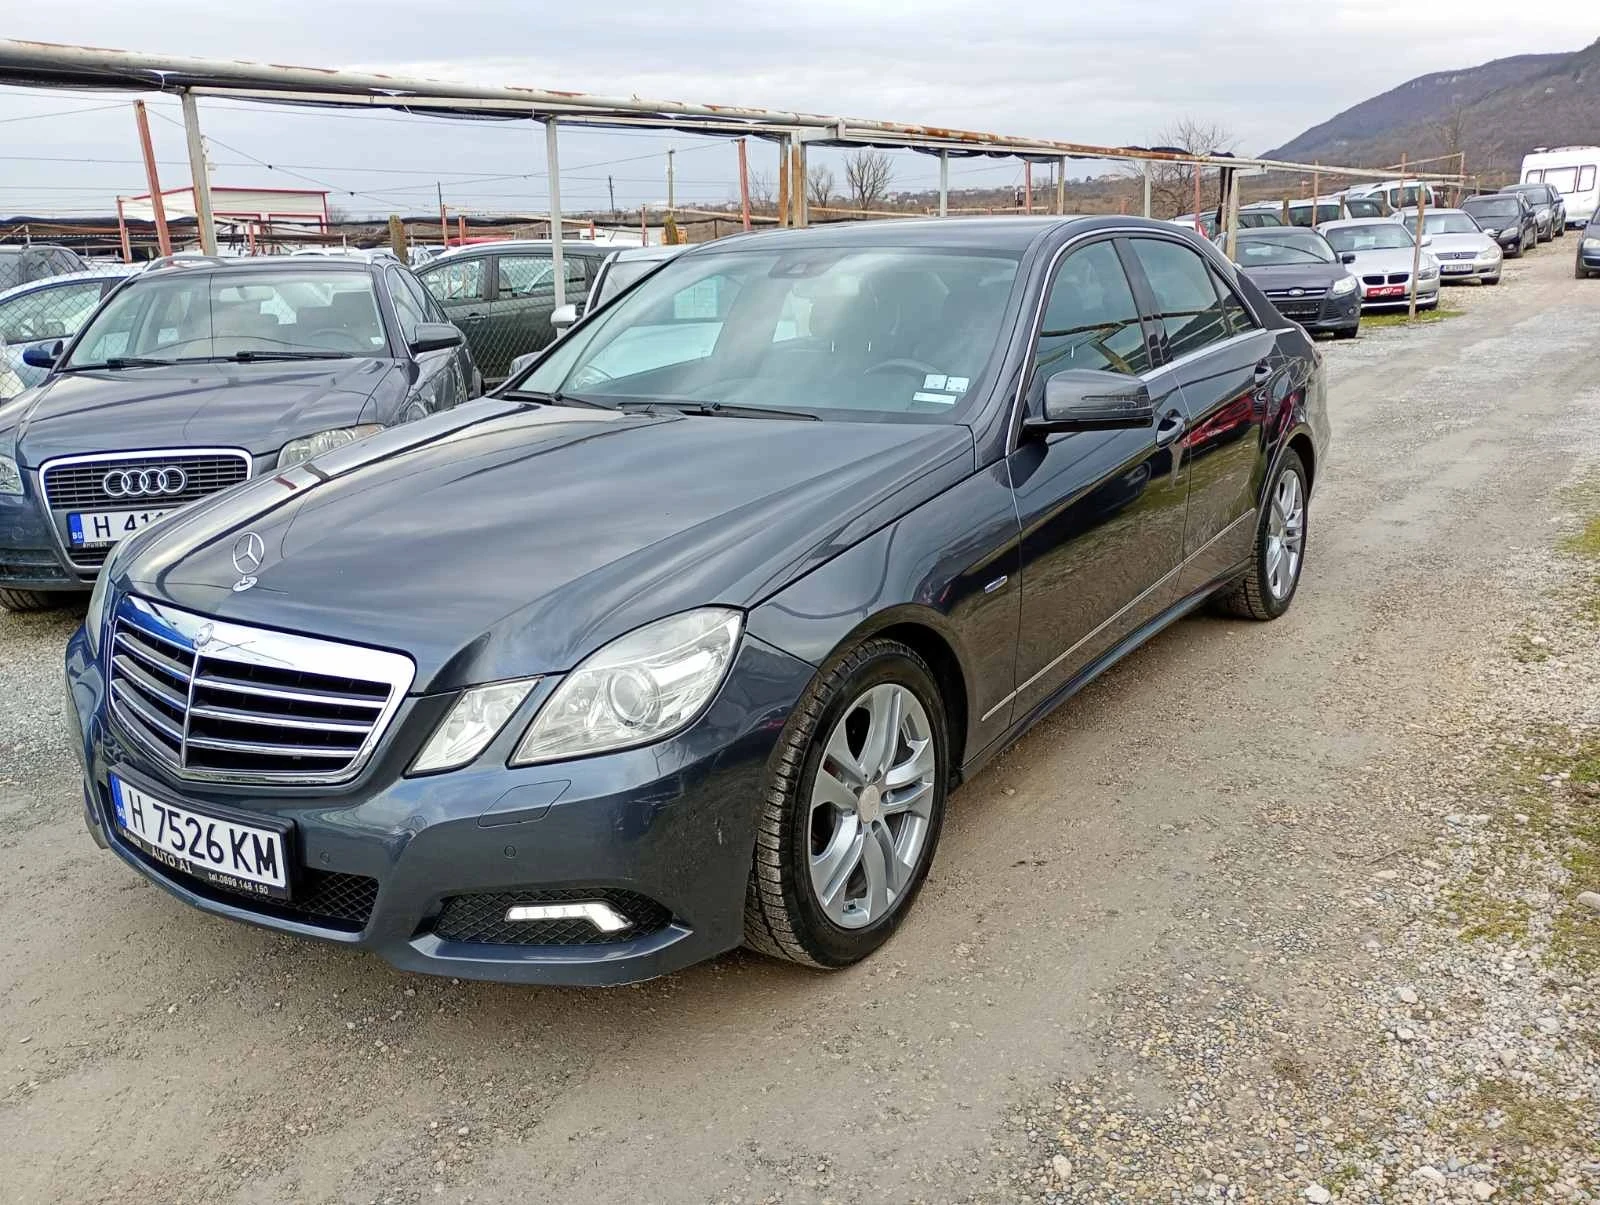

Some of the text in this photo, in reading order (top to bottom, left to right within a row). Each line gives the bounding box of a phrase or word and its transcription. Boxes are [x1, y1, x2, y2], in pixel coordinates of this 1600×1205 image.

[93, 516, 111, 537] H
[129, 790, 279, 879] H 7526 KM
[151, 845, 176, 868] AUTO
